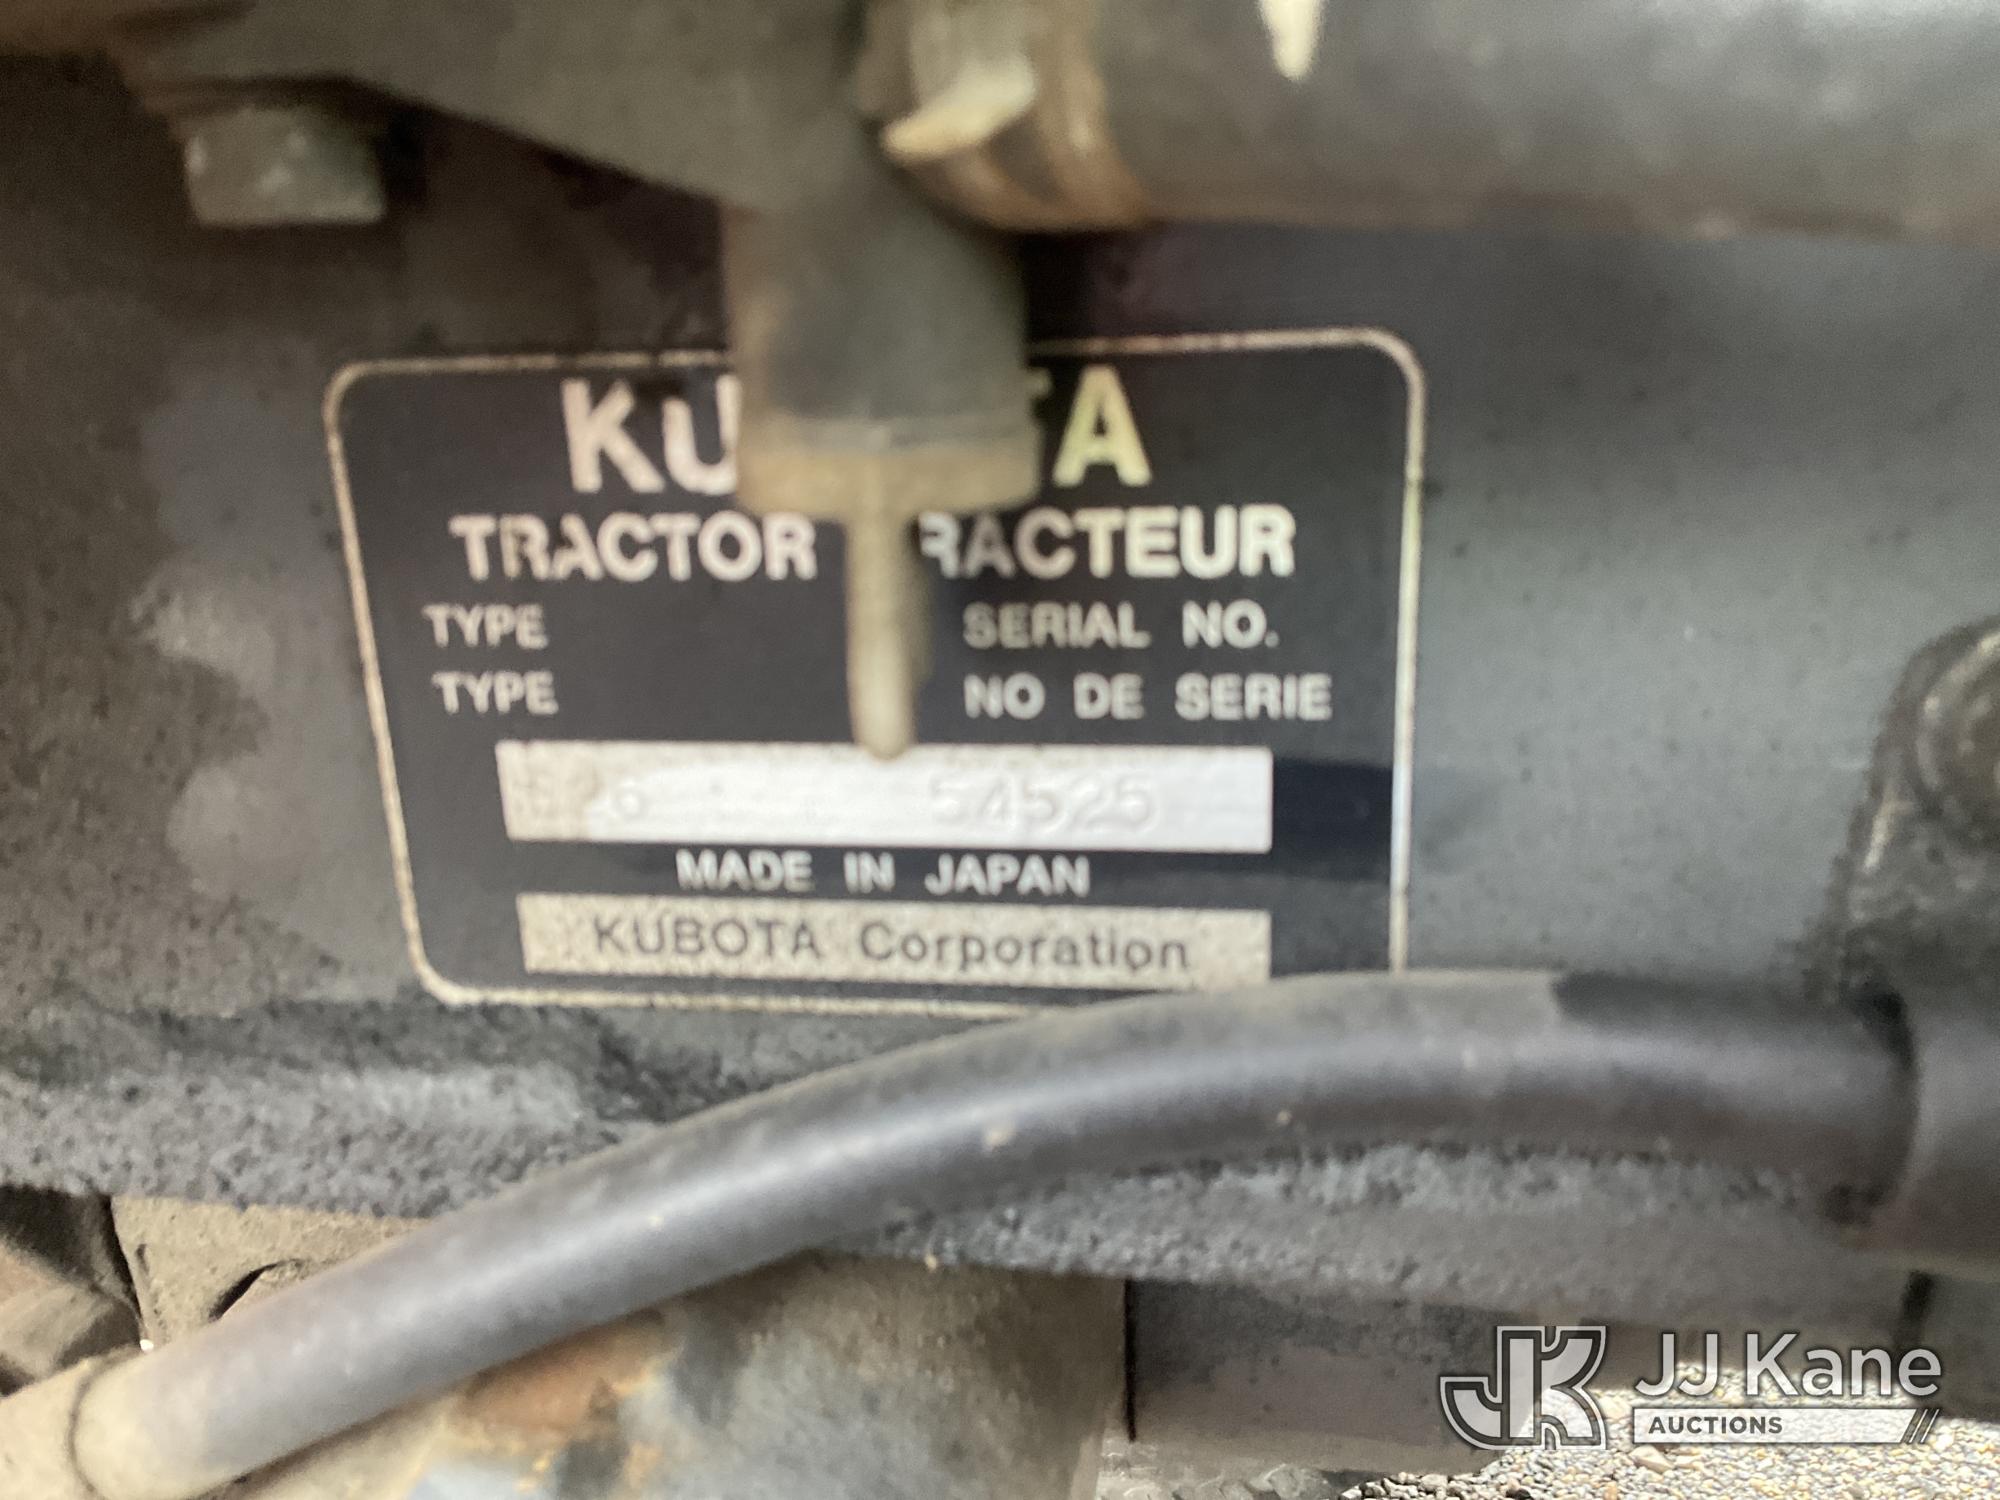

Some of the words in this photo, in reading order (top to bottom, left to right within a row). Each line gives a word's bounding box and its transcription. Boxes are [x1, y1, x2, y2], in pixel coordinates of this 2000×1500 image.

[560, 364, 1152, 495] KUA
[447, 510, 819, 582] TRACTOR
[912, 502, 1297, 580] RACTEUR
[421, 603, 550, 650] TYPE
[962, 600, 1152, 650] SERIAL
[1181, 599, 1280, 649] NO.
[431, 670, 559, 716] TYPE
[963, 672, 1046, 720] NO
[1073, 672, 1145, 720] DE
[1174, 672, 1334, 721] SERIE
[675, 848, 814, 893] MADE
[843, 851, 896, 894] IN
[923, 853, 1091, 897] JAPAN
[593, 912, 823, 961] KUBOTA
[858, 919, 1190, 972] Corporation
